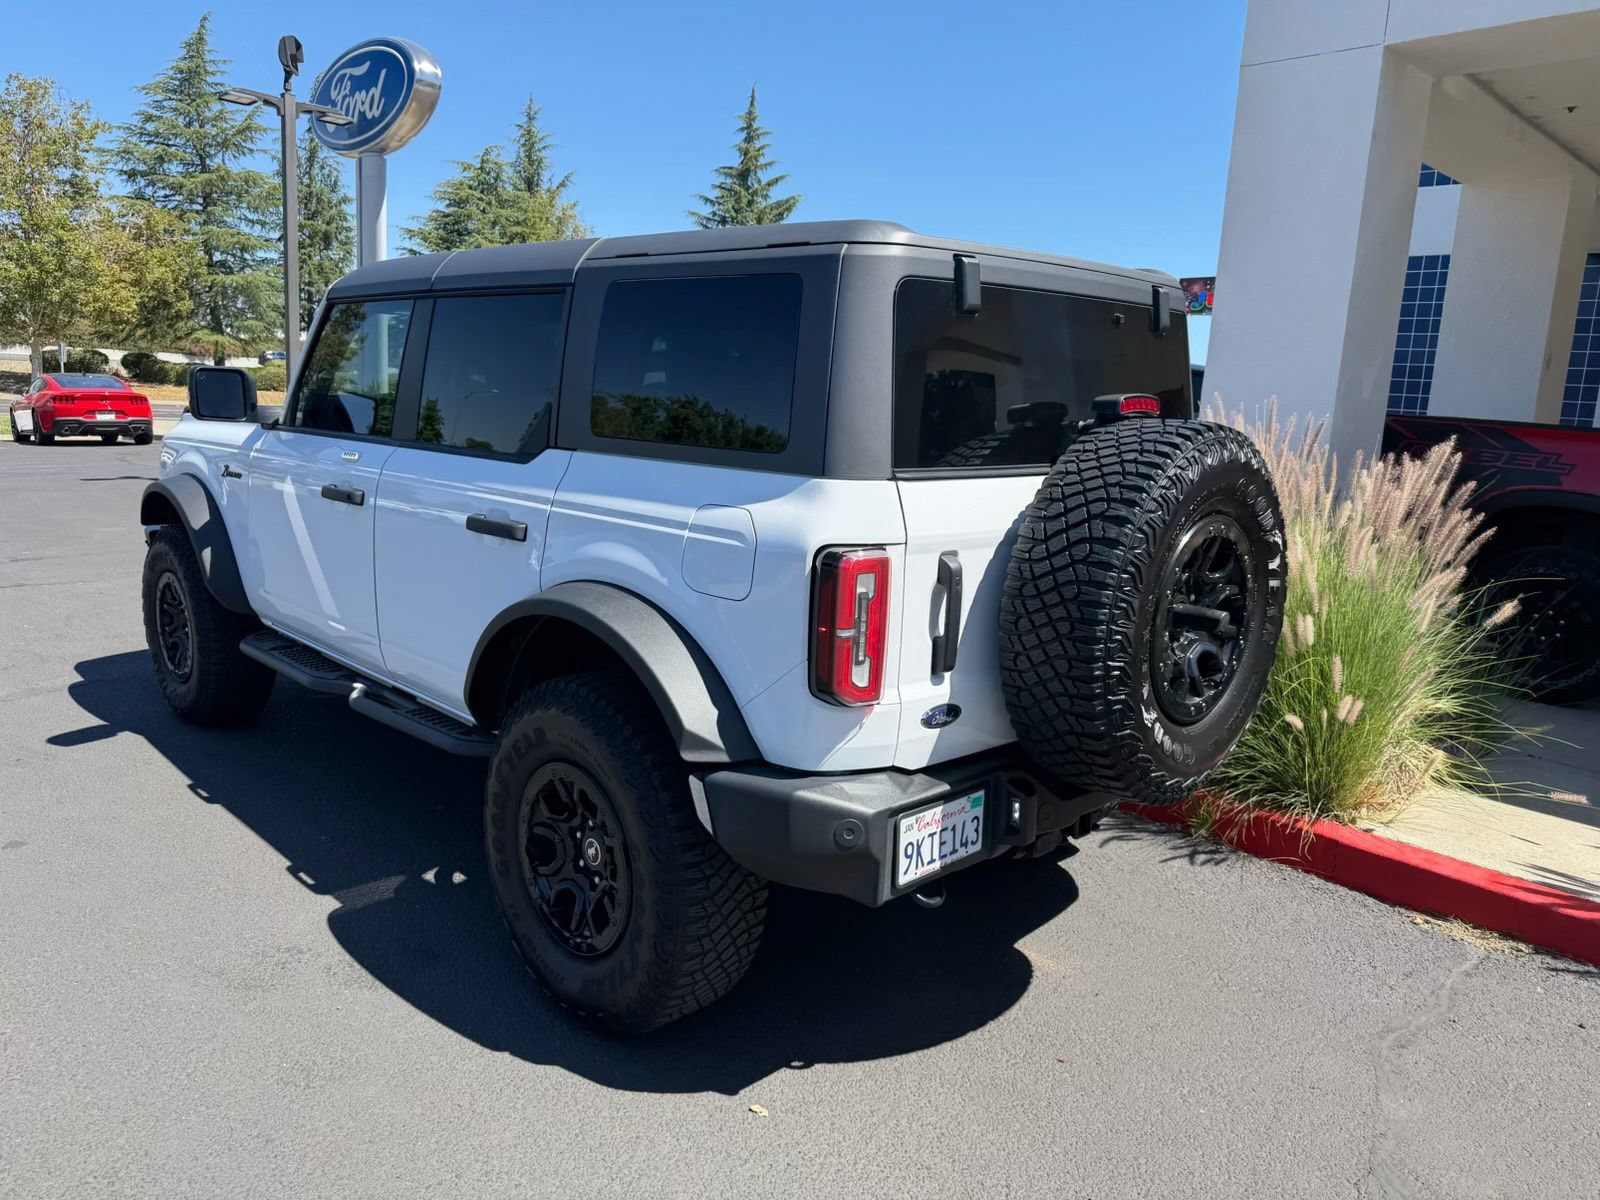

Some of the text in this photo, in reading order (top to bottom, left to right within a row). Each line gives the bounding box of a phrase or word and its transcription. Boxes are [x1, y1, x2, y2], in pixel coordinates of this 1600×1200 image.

[327, 61, 387, 133] Ford
[903, 815, 980, 876] 9KIE143
[916, 805, 970, 832] California
